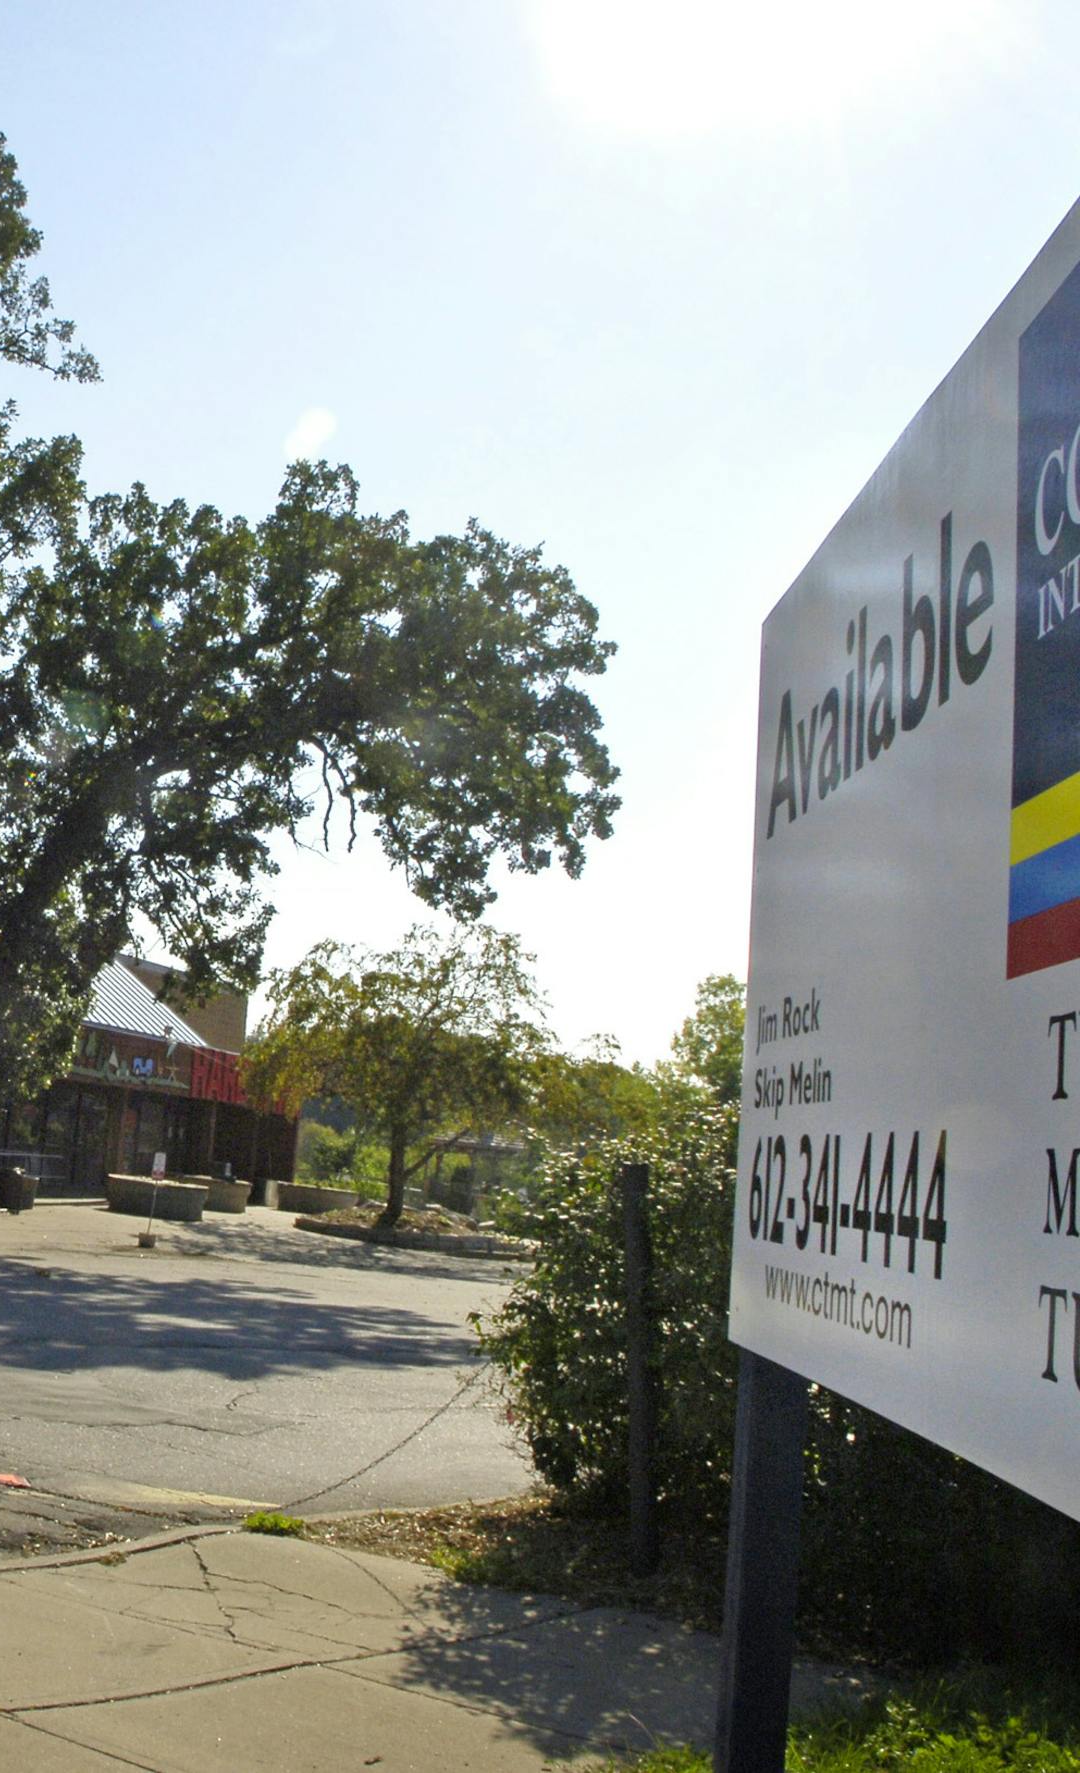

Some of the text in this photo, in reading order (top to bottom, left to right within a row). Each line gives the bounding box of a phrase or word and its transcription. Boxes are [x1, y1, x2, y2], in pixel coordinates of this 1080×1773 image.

[767, 510, 994, 840] Available
[756, 987, 820, 1056] Jim Rock
[755, 1058, 831, 1120] Skip Melin
[749, 1129, 947, 1280] 612-341-4444
[765, 1265, 912, 1348] www.ctmt.com
